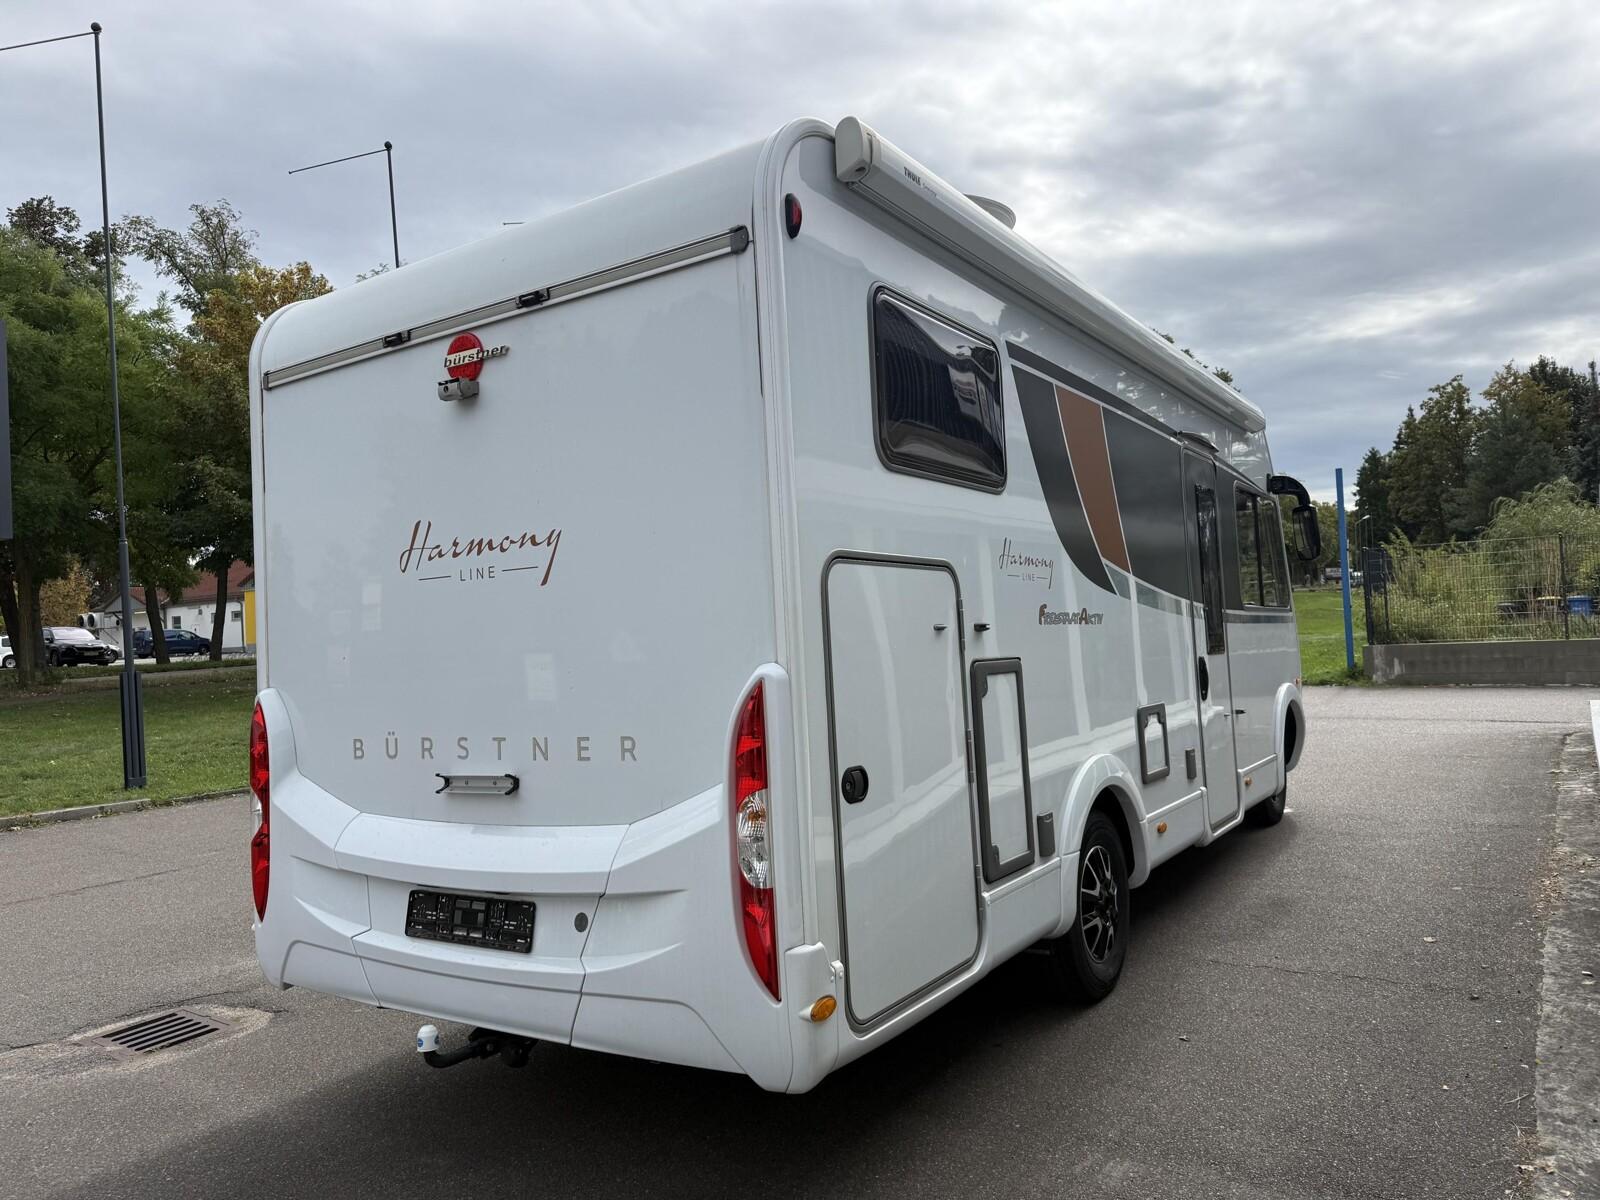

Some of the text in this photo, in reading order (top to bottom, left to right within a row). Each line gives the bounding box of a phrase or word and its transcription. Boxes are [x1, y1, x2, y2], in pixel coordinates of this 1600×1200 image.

[444, 345, 509, 368] bürstner
[399, 519, 562, 587] Harmony
[999, 537, 1054, 590] Harmony
[459, 565, 496, 582] LINE
[1021, 573, 1036, 582] LINE
[352, 731, 637, 762] BÜRSTNER
